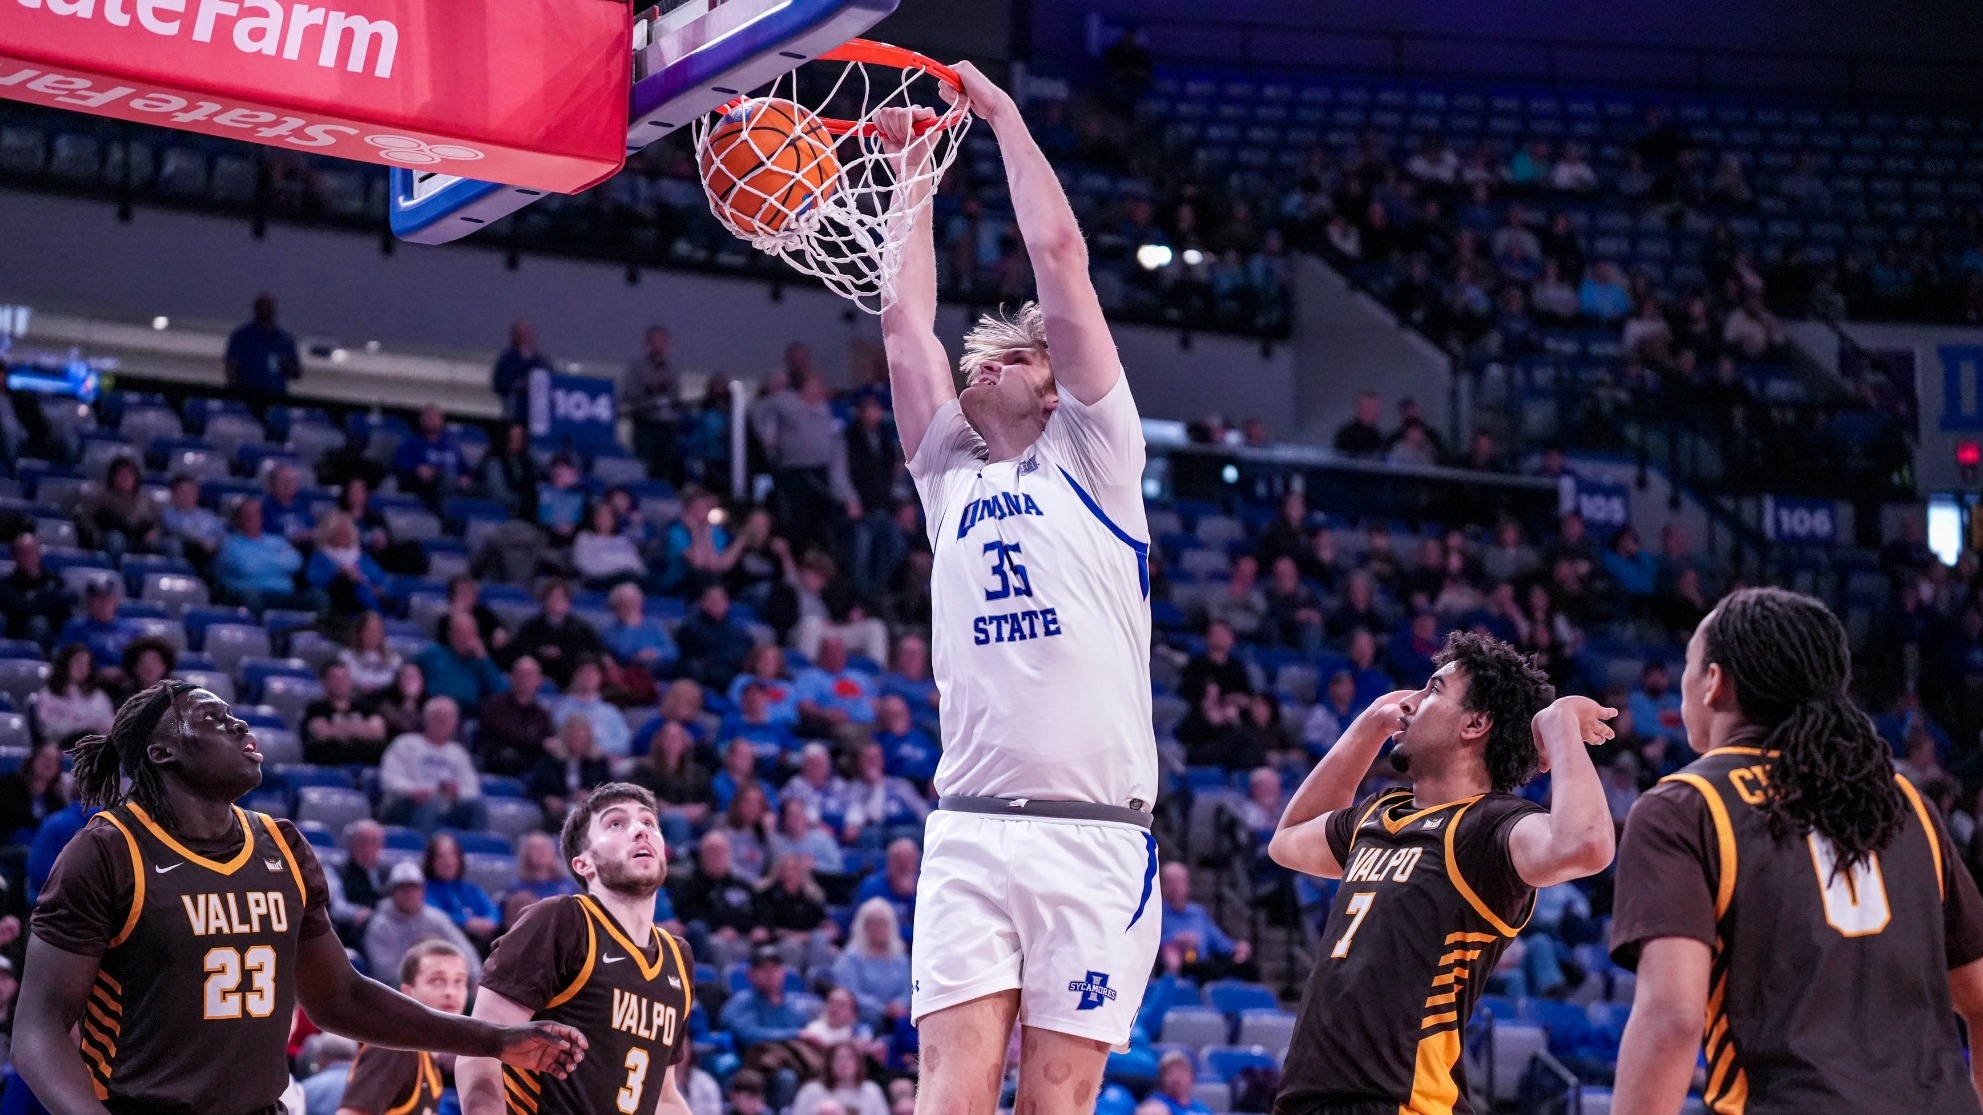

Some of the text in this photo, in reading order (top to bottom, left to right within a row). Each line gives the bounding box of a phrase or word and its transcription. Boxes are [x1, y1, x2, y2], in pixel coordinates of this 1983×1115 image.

[554, 388, 613, 423] 104
[1579, 494, 1627, 525] 105
[1778, 507, 1833, 538] 106
[983, 540, 1034, 602] 35
[973, 608, 1062, 646] STATE
[1345, 847, 1424, 883] VALPO
[181, 891, 289, 936] VALPO
[1330, 892, 1377, 958] 7
[203, 945, 277, 1020] 23
[1069, 982, 1117, 1001] SYCAMORES
[611, 987, 677, 1047] VALPO
[616, 1046, 650, 1115] 3
